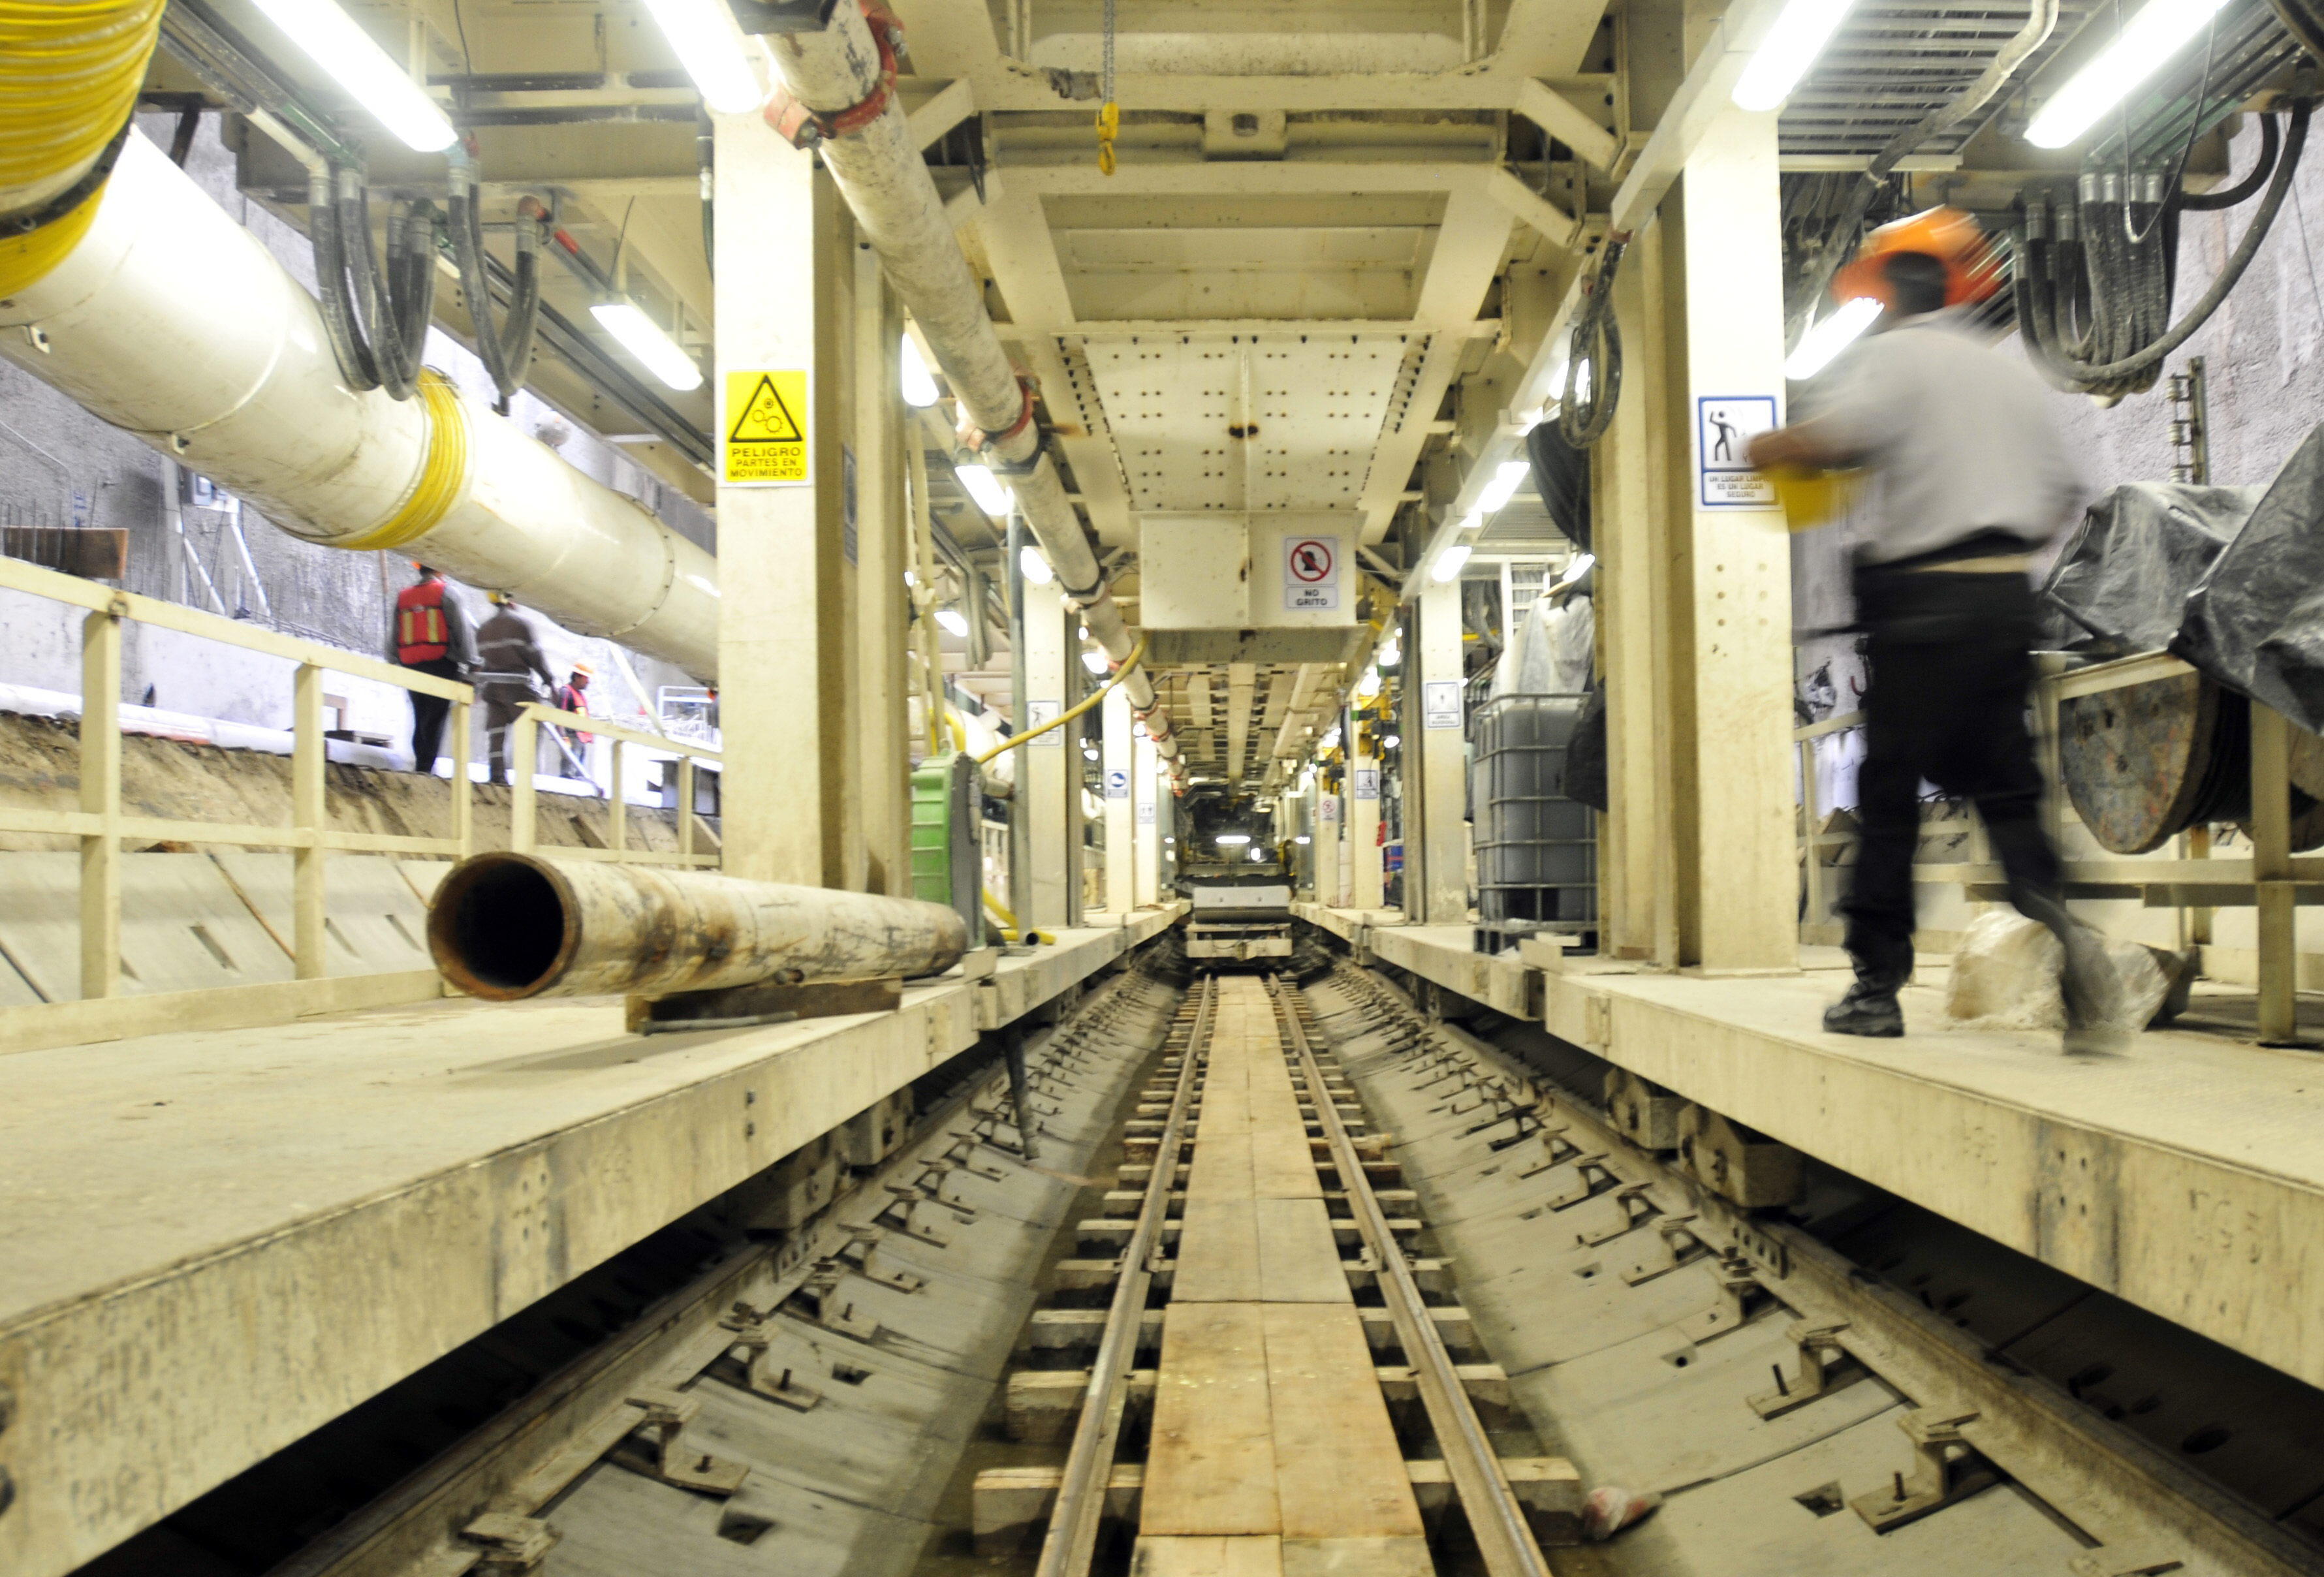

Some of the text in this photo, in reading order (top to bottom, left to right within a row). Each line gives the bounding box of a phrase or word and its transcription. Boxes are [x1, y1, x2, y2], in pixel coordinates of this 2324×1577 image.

[732, 447, 801, 457] PELIGRO
[736, 458, 778, 467] PARTES
[730, 468, 802, 477] MOVIMIENTO
